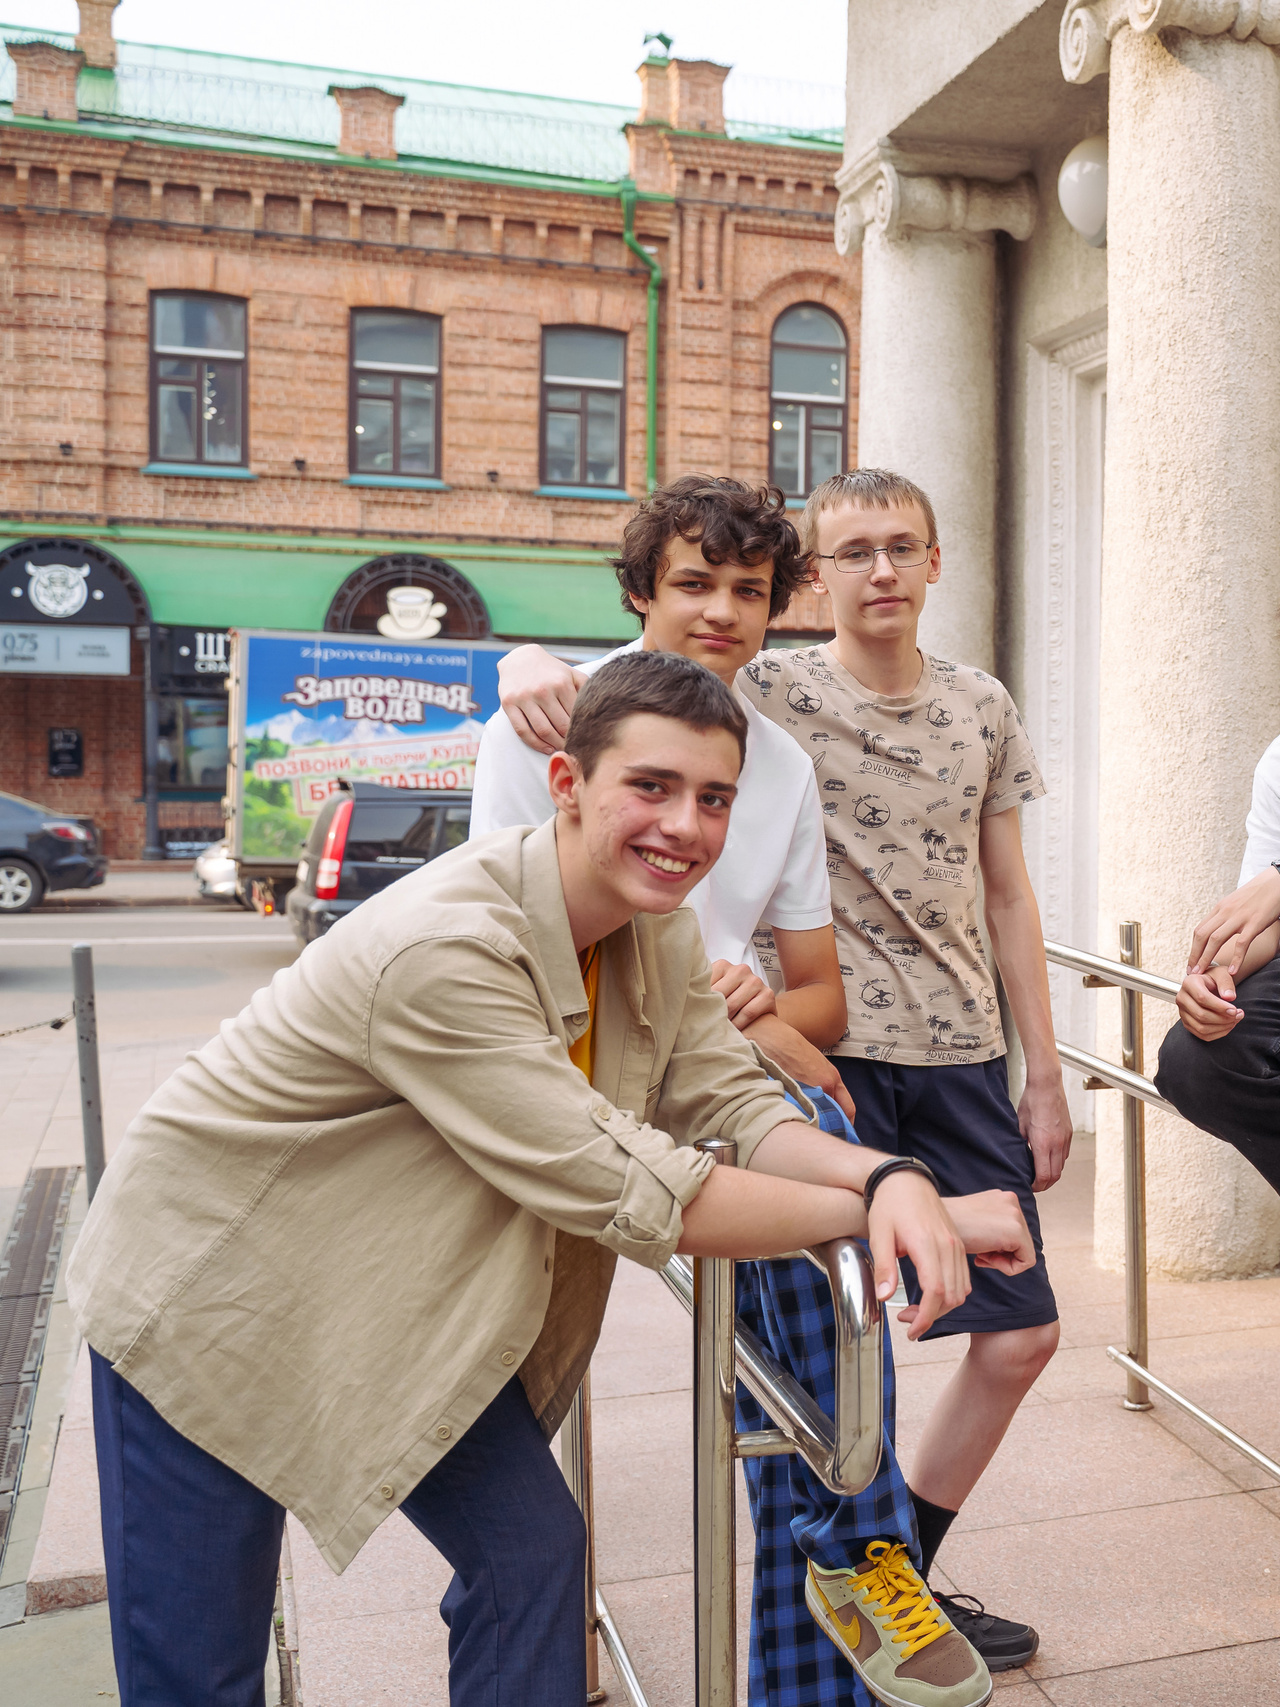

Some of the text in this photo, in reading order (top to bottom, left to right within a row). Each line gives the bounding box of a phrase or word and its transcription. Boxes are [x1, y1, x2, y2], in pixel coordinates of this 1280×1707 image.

[301, 647, 467, 666] zapovednaya.com
[194, 660, 229, 673] CRA
[257, 756, 351, 778] ПОЗВОНИ
[858, 760, 912, 782] ADVENTURE
[923, 866, 962, 882] ADVENTURE
[924, 1050, 973, 1064] ADVENTURE
